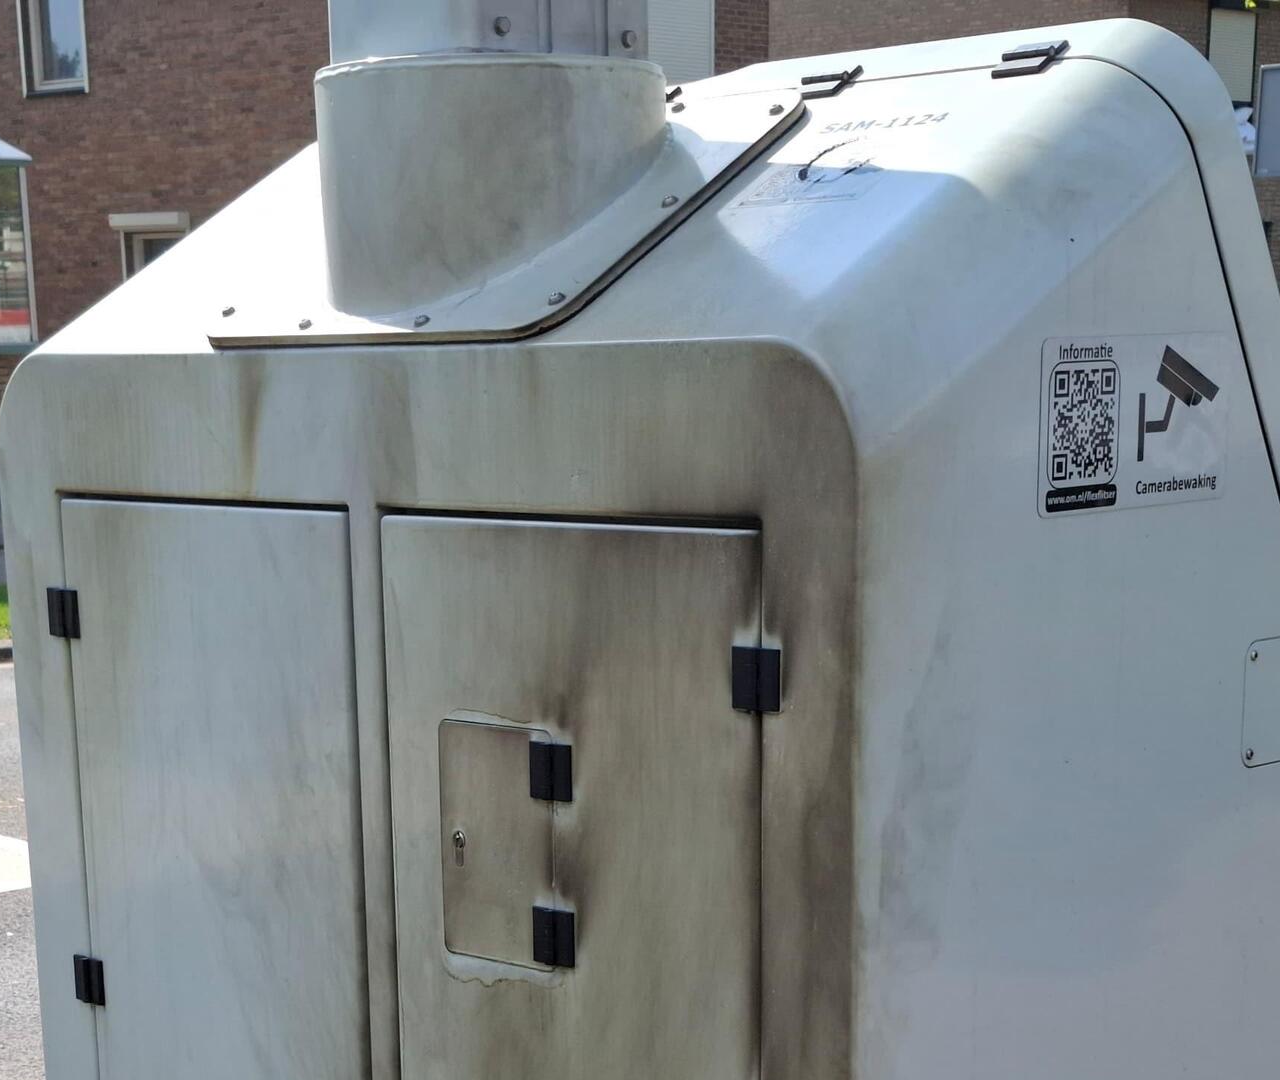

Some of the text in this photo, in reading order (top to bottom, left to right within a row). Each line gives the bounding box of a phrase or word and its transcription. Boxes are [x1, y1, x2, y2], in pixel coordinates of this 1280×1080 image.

[819, 111, 950, 134] SAM-1124
[1059, 343, 1114, 361] Informatie
[1135, 474, 1217, 495] Camerabewaking
